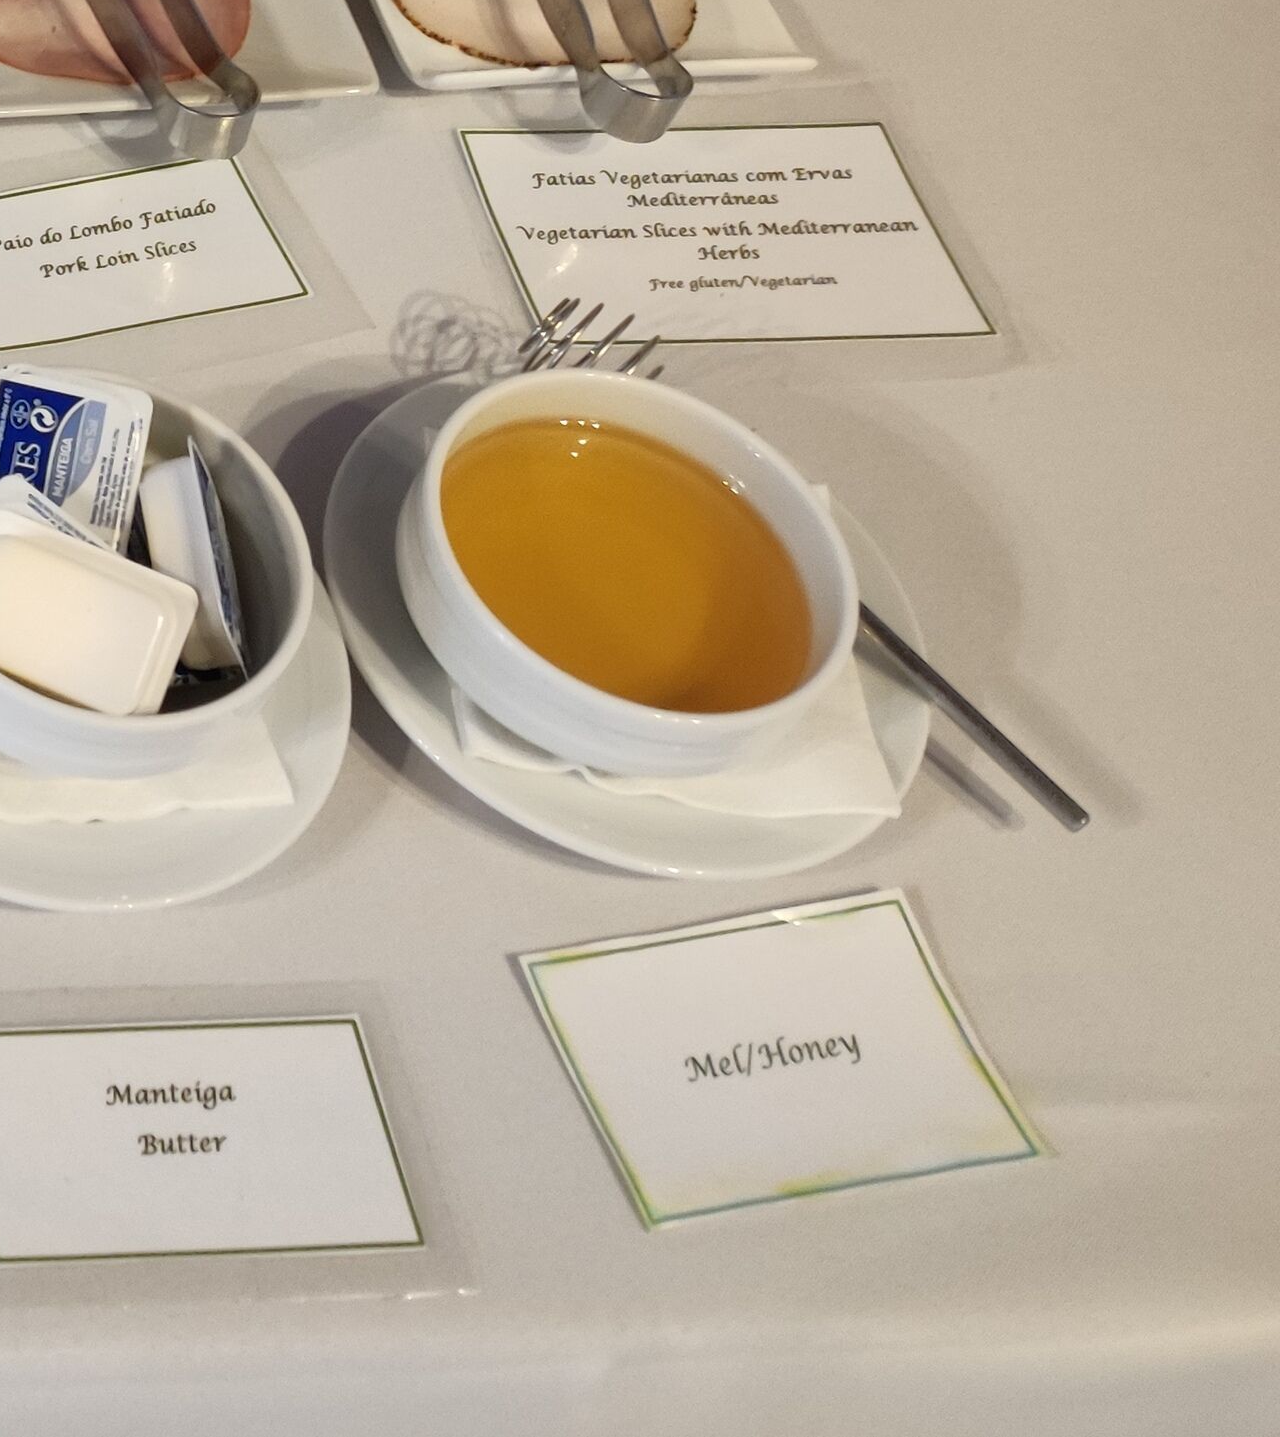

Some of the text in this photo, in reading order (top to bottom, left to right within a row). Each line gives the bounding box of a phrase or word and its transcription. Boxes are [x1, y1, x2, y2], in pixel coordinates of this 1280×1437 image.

[532, 166, 853, 189] Fatias Vegetarianas com Ervas
[627, 190, 779, 208] Mediterrâneas
[40, 227, 63, 246] do
[68, 215, 134, 241] Lombo
[139, 198, 217, 231] Fatiado
[517, 218, 919, 245] Vegetarian Slices with Mediterranean
[40, 238, 198, 278] Pork Loin Slices
[697, 244, 761, 261] Herbs
[649, 273, 838, 292] Free gluten/Vegetarian
[51, 437, 73, 498] MANTEIGA
[684, 1030, 862, 1083] Mel/Honey
[105, 1079, 237, 1111] Manteiga
[137, 1133, 227, 1156] Butter
